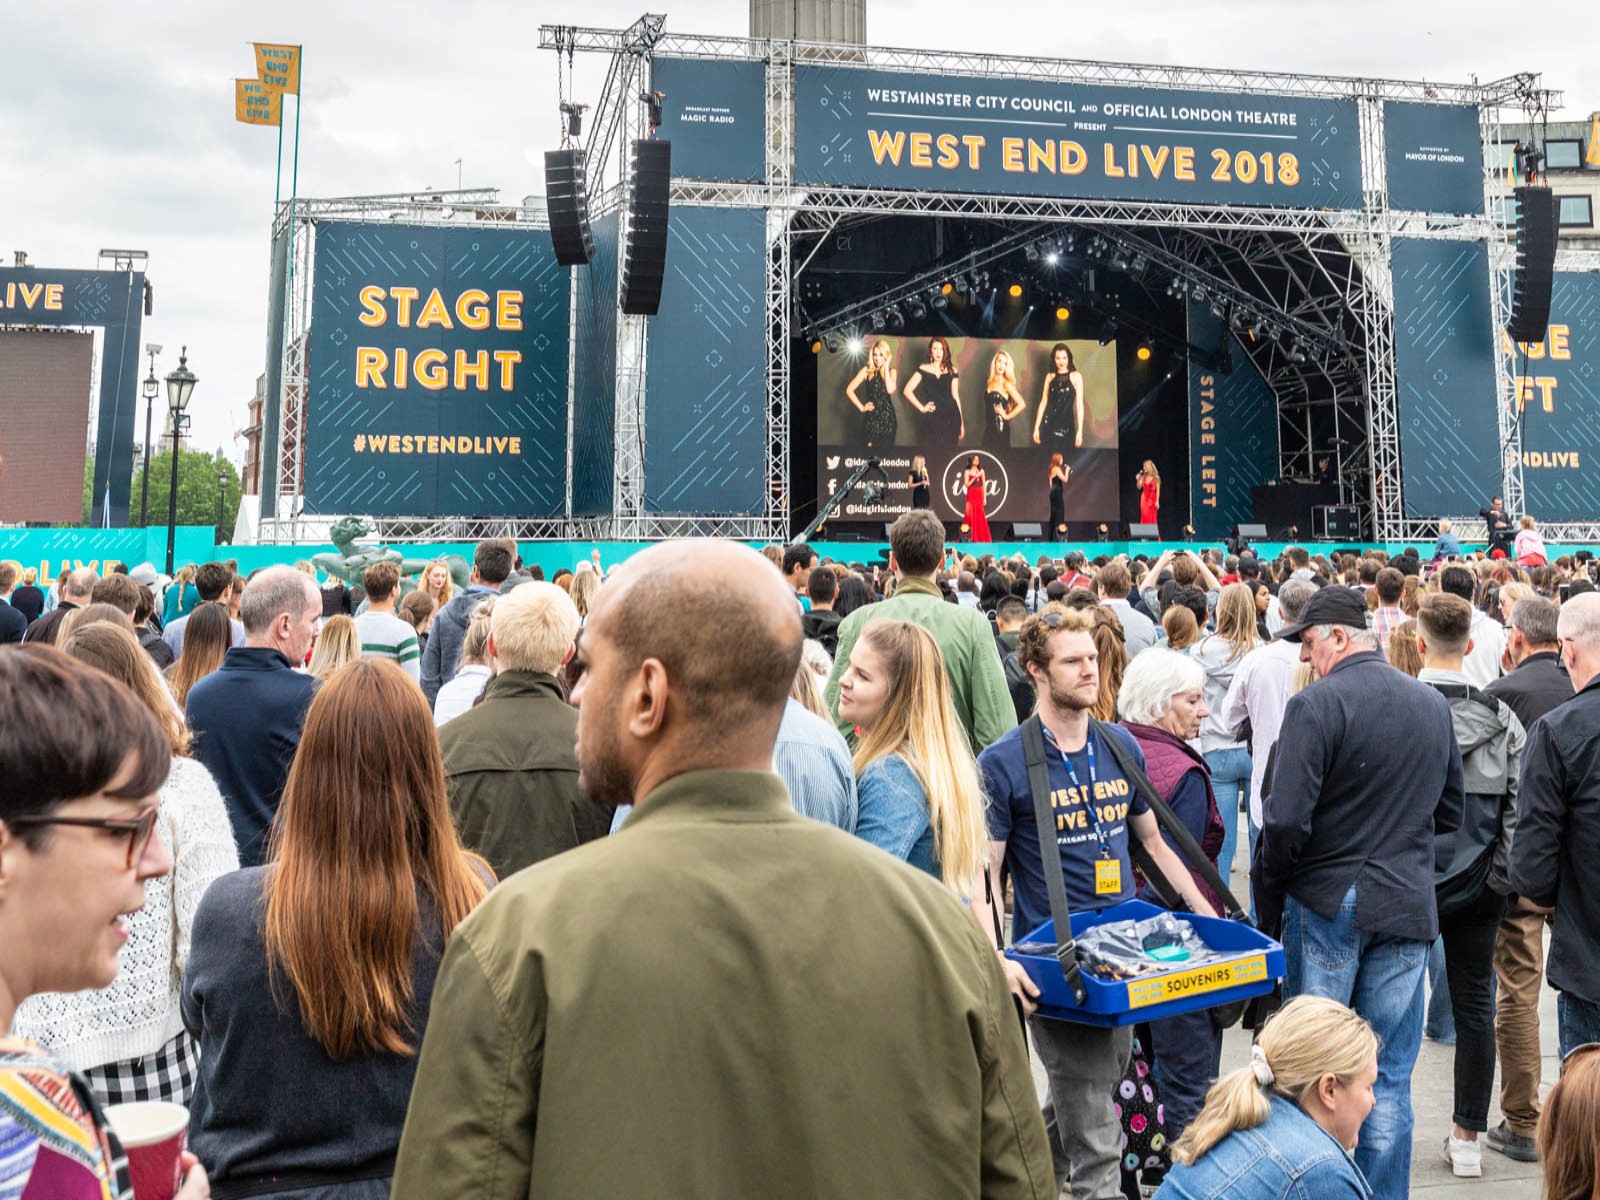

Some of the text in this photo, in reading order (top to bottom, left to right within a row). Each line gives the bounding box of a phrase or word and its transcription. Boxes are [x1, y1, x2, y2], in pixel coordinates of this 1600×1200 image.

[680, 113, 735, 124] MAGIC RADIO
[867, 88, 1297, 126] WESTMINSTER CITY COUNCIL AND OFFICIAL LONDON THEATRE
[1073, 121, 1107, 132] PRESENT
[867, 130, 1300, 187] WEST END LIVE 2018
[1405, 152, 1465, 163] MAYOR OF LONDON
[0, 282, 64, 311] IVE
[358, 285, 524, 331] STAGE
[355, 346, 522, 391] RIGHT
[1200, 375, 1215, 444] STAGE
[353, 434, 521, 454] #WESTENDLIVE
[1202, 455, 1217, 507] LEFT
[1093, 779, 1129, 800] END
[1057, 810, 1088, 830] IVE
[1167, 968, 1231, 993] SOUVENIRS
